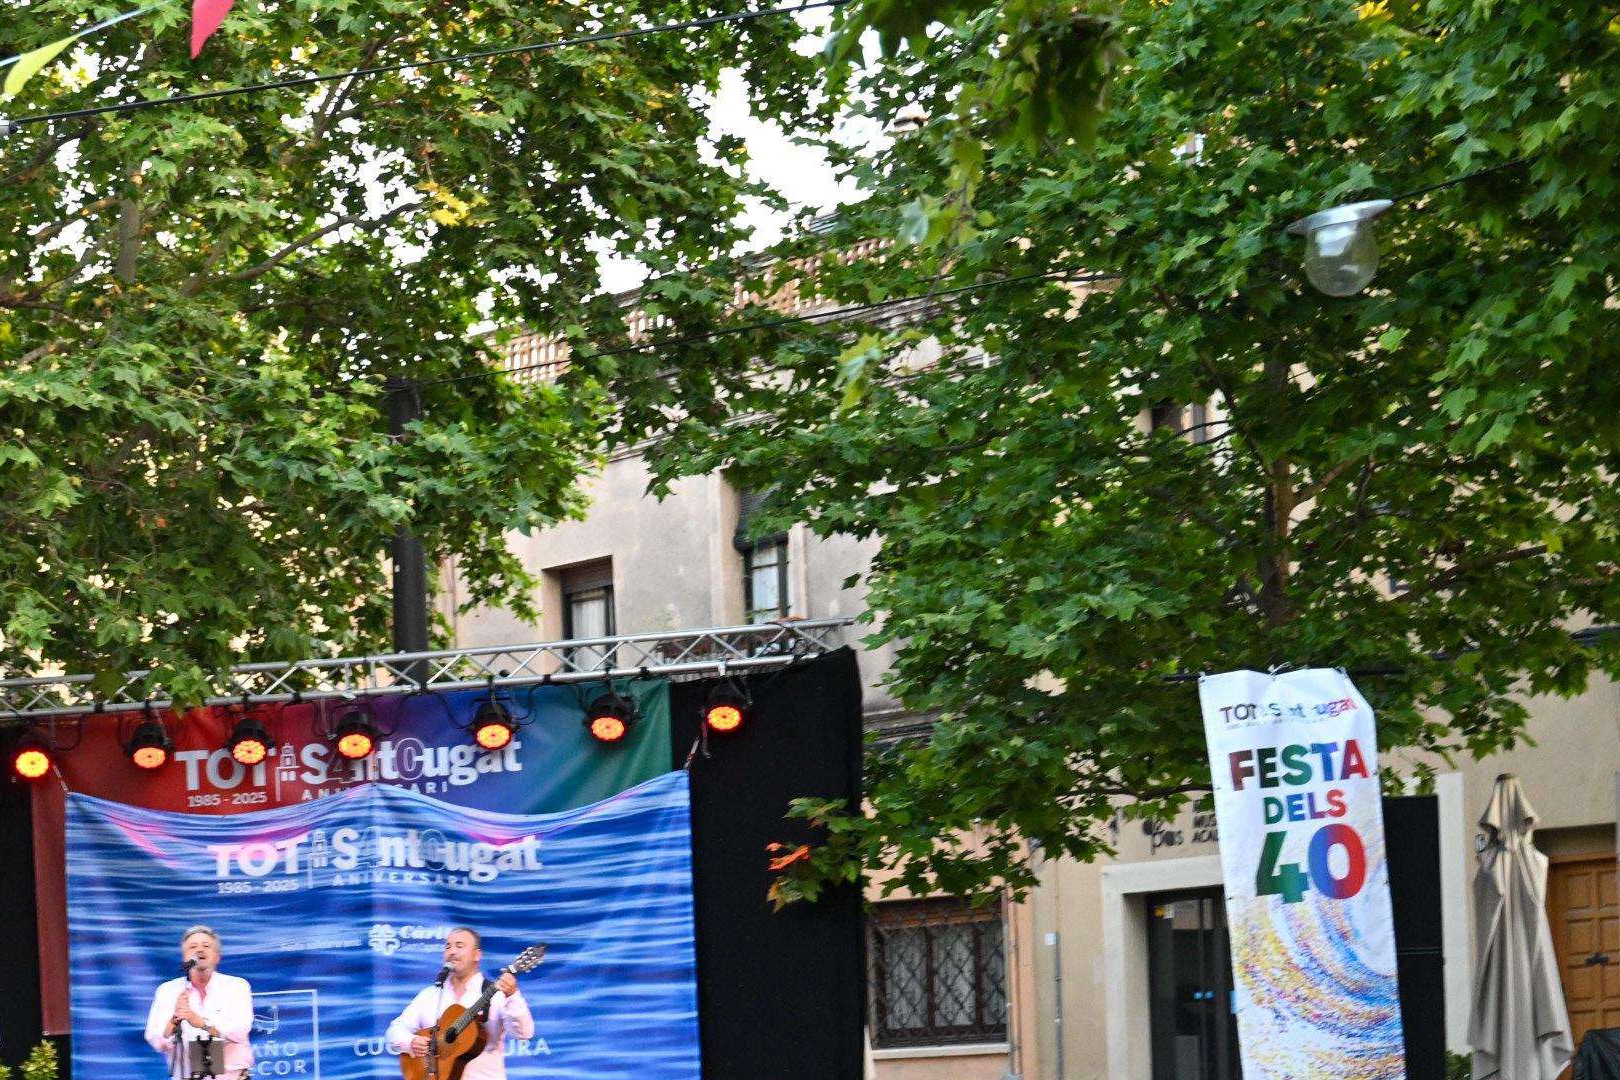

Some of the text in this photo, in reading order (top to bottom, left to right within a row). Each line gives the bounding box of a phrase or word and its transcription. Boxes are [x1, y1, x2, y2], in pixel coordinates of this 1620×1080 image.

[174, 744, 277, 791] TOT
[1229, 739, 1370, 791] FESTA
[188, 794, 221, 807] 1985
[232, 791, 267, 805] 2025
[1262, 789, 1348, 825] DELS
[207, 833, 309, 877] TOT
[1256, 823, 1367, 904] 40
[218, 881, 253, 893] 1985
[263, 879, 299, 892] 2025
[252, 1040, 300, 1058] AÑO
